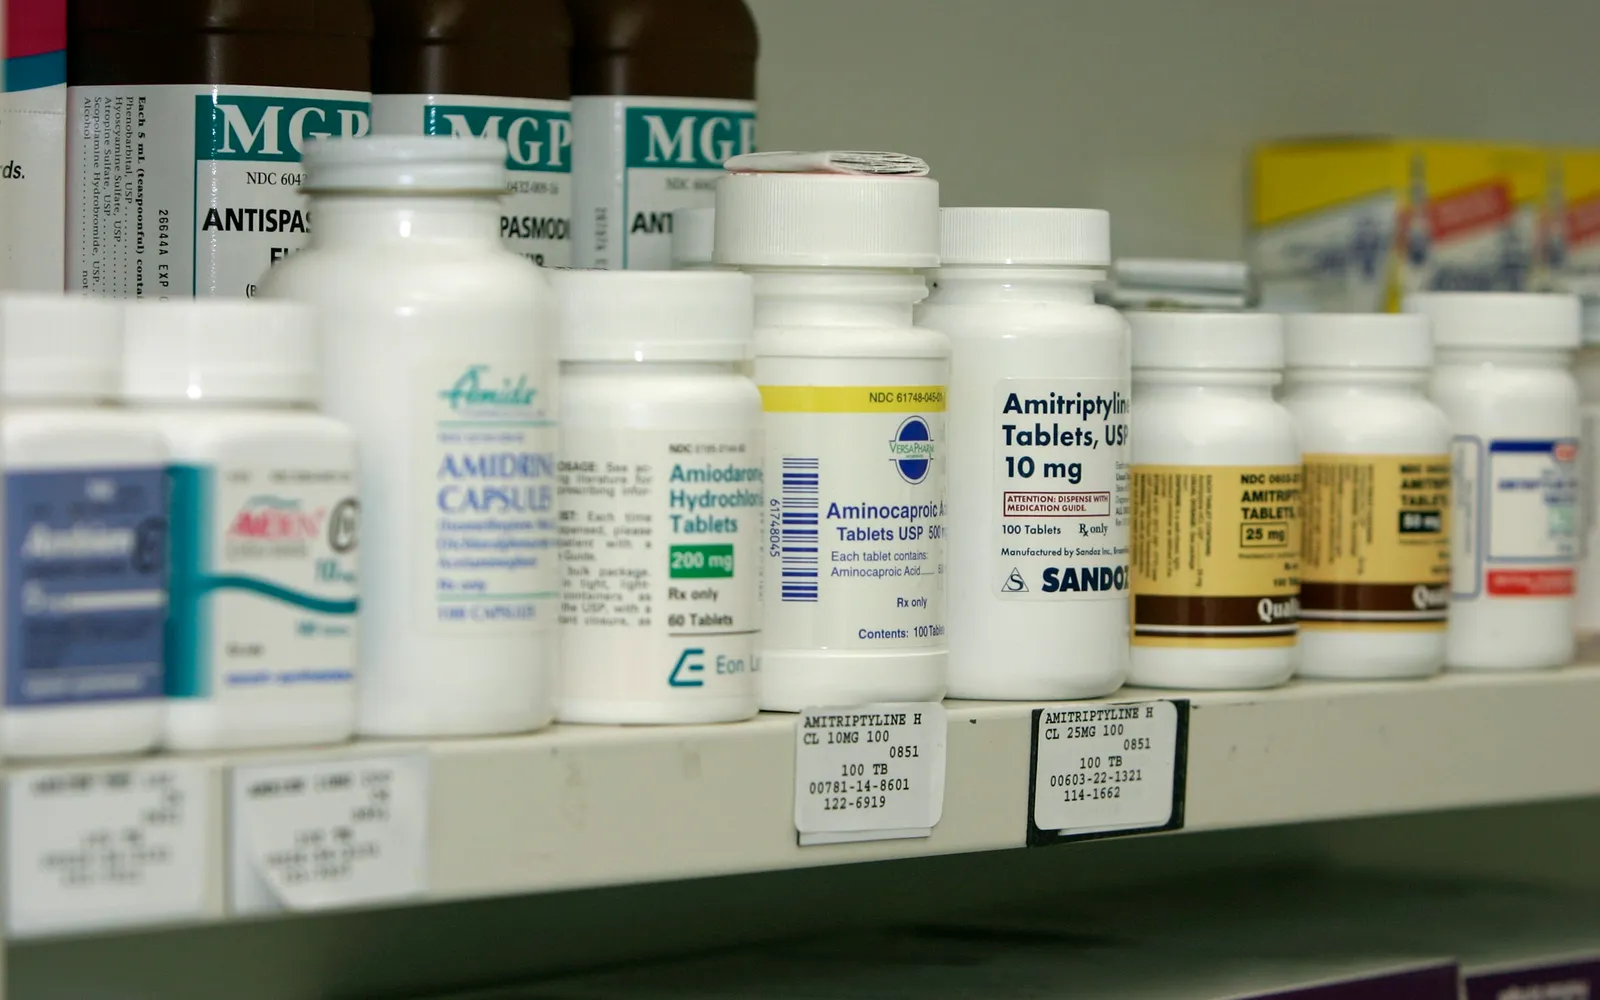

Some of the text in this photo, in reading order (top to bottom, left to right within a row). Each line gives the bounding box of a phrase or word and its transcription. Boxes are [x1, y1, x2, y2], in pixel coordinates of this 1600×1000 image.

[83, 97, 91, 140] Alcohol
[138, 96, 146, 127] Each
[92, 97, 102, 169] Scopolamine
[138, 131, 146, 139] 5
[103, 97, 112, 216] Atropine Sulfate, USP
[124, 96, 134, 204] Phenobarbital, USP
[137, 143, 146, 164] mL
[0, 160, 25, 179] ds.
[113, 97, 123, 242] Hyoscyamine Sulfate, USP
[246, 172, 277, 185] NDC
[92, 172, 101, 256] Hydrobromide,
[135, 168, 145, 254] (teaspoonful)
[158, 209, 169, 288] 26644A EXP
[869, 392, 894, 403] NDC
[1002, 423, 1129, 450] Tablets, USP
[1005, 456, 1082, 485] 10 mg
[1240, 474, 1265, 484] NDC
[1007, 495, 1057, 503] ATTENTION:
[1058, 495, 1093, 503] DISPENSE
[826, 501, 938, 523] Aminocaproic
[1007, 504, 1087, 512] MEDICATION GUIDE.
[669, 514, 738, 534] Tablets
[769, 498, 781, 557] 61748045
[1002, 525, 1022, 535] 100
[1024, 524, 1062, 535] Tablets
[1090, 523, 1109, 536] only
[836, 525, 941, 541] Tablets USP 500
[1245, 528, 1285, 542] 25 mg
[831, 549, 929, 562] Each tablet contains:
[1001, 548, 1062, 556] Manufactured
[1064, 547, 1075, 558] by
[1075, 547, 1100, 556] Sandoz
[671, 551, 733, 572] 200 mg
[831, 566, 921, 579] Aminocaproic Acid
[668, 587, 719, 602] Rx only
[896, 597, 928, 609] Rx only
[668, 613, 733, 627] 60 Tablets
[858, 628, 909, 640] Contents:
[913, 626, 929, 638] 100
[716, 655, 745, 674] Eon
[803, 713, 922, 729] AMITRIPTYLINE H
[1045, 707, 1154, 724] AMITRIPTYLINE H
[803, 730, 890, 745] CL 10MG 100
[1045, 724, 1124, 740] CL 25MG 100
[889, 745, 920, 758] 0851
[1123, 738, 1151, 751] 0851
[841, 764, 889, 777] 100 TB
[1079, 756, 1123, 770] 100 TB
[1050, 769, 1142, 787] 00603-22-1321
[809, 778, 910, 795] 00781-14-8601
[1064, 786, 1121, 802] 114-1662
[823, 796, 886, 810] 122-6919
